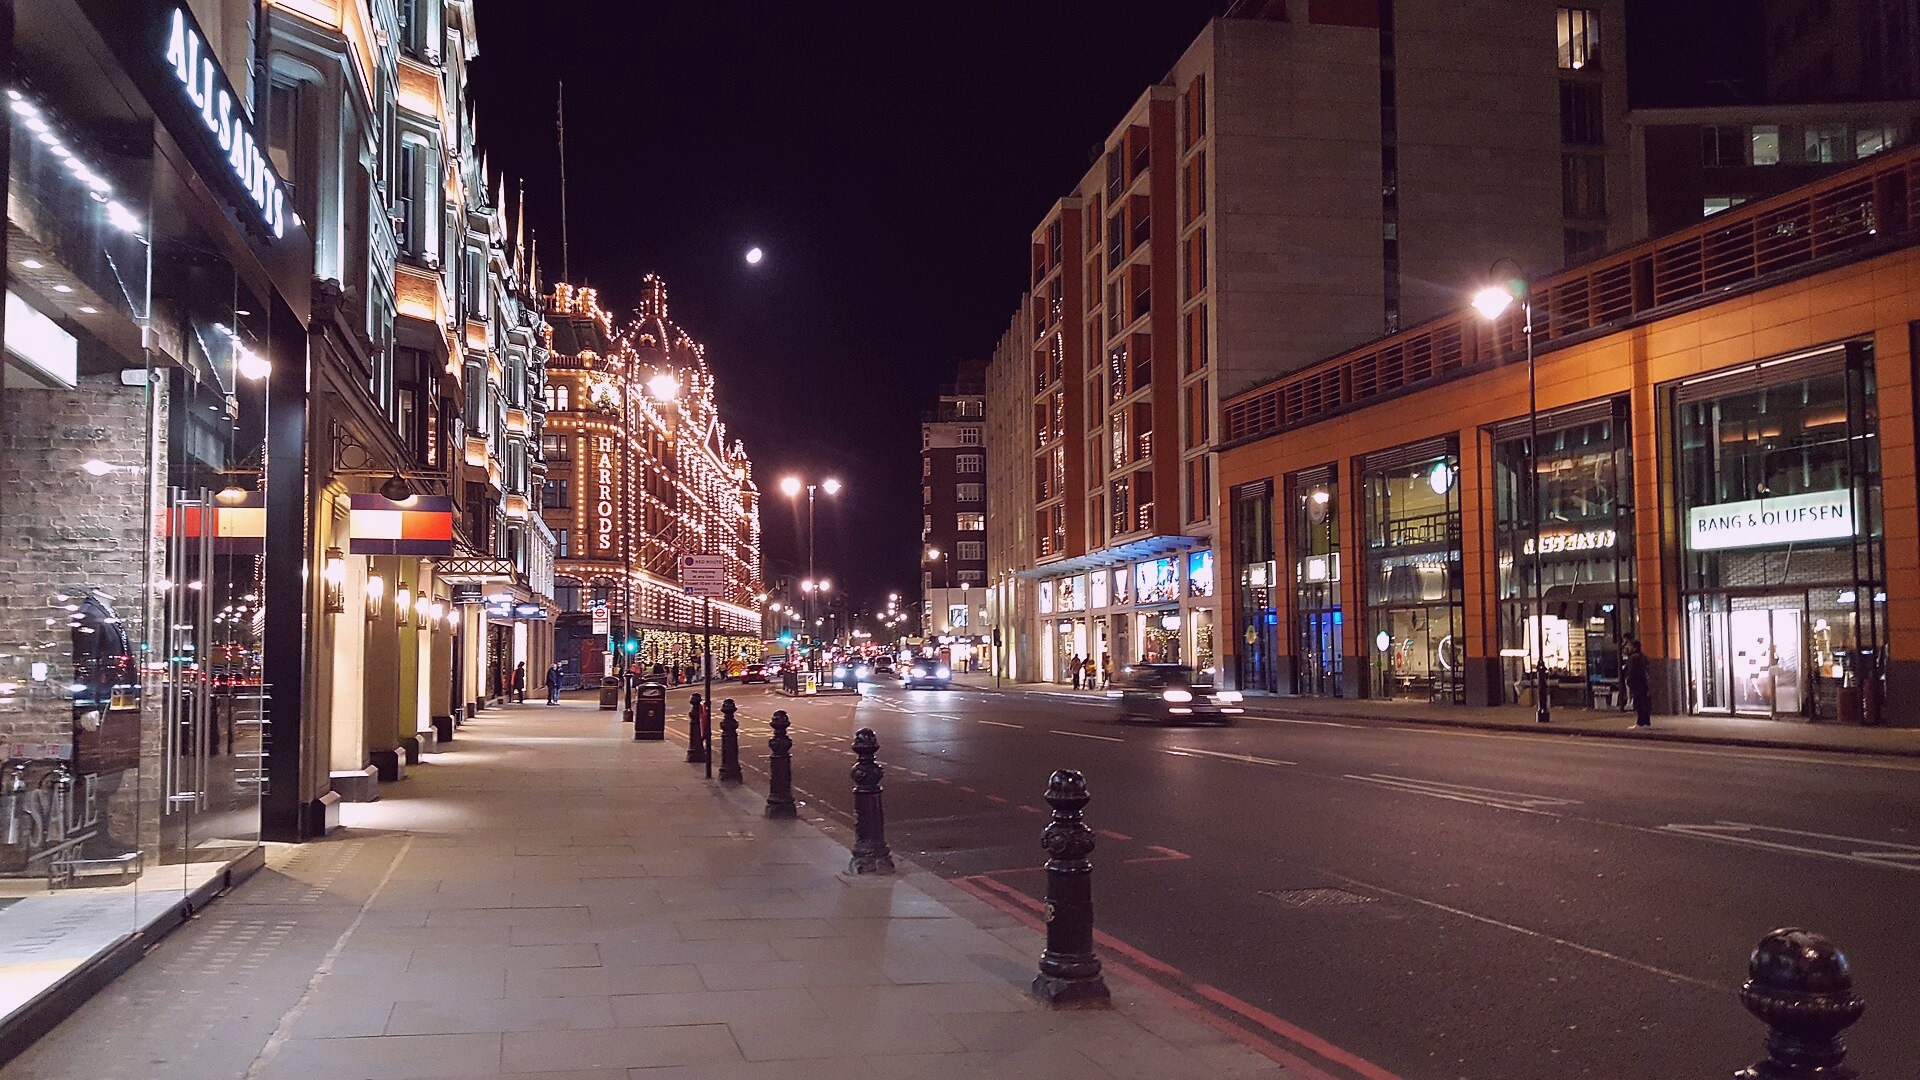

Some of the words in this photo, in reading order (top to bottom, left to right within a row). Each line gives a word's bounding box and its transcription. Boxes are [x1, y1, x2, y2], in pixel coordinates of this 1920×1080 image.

[167, 7, 283, 239] ALLSAINTS
[598, 436, 613, 549] HARRODS
[1698, 515, 1742, 532] BANG
[1748, 513, 1757, 527] &
[1762, 504, 1844, 526] OLUFSEN
